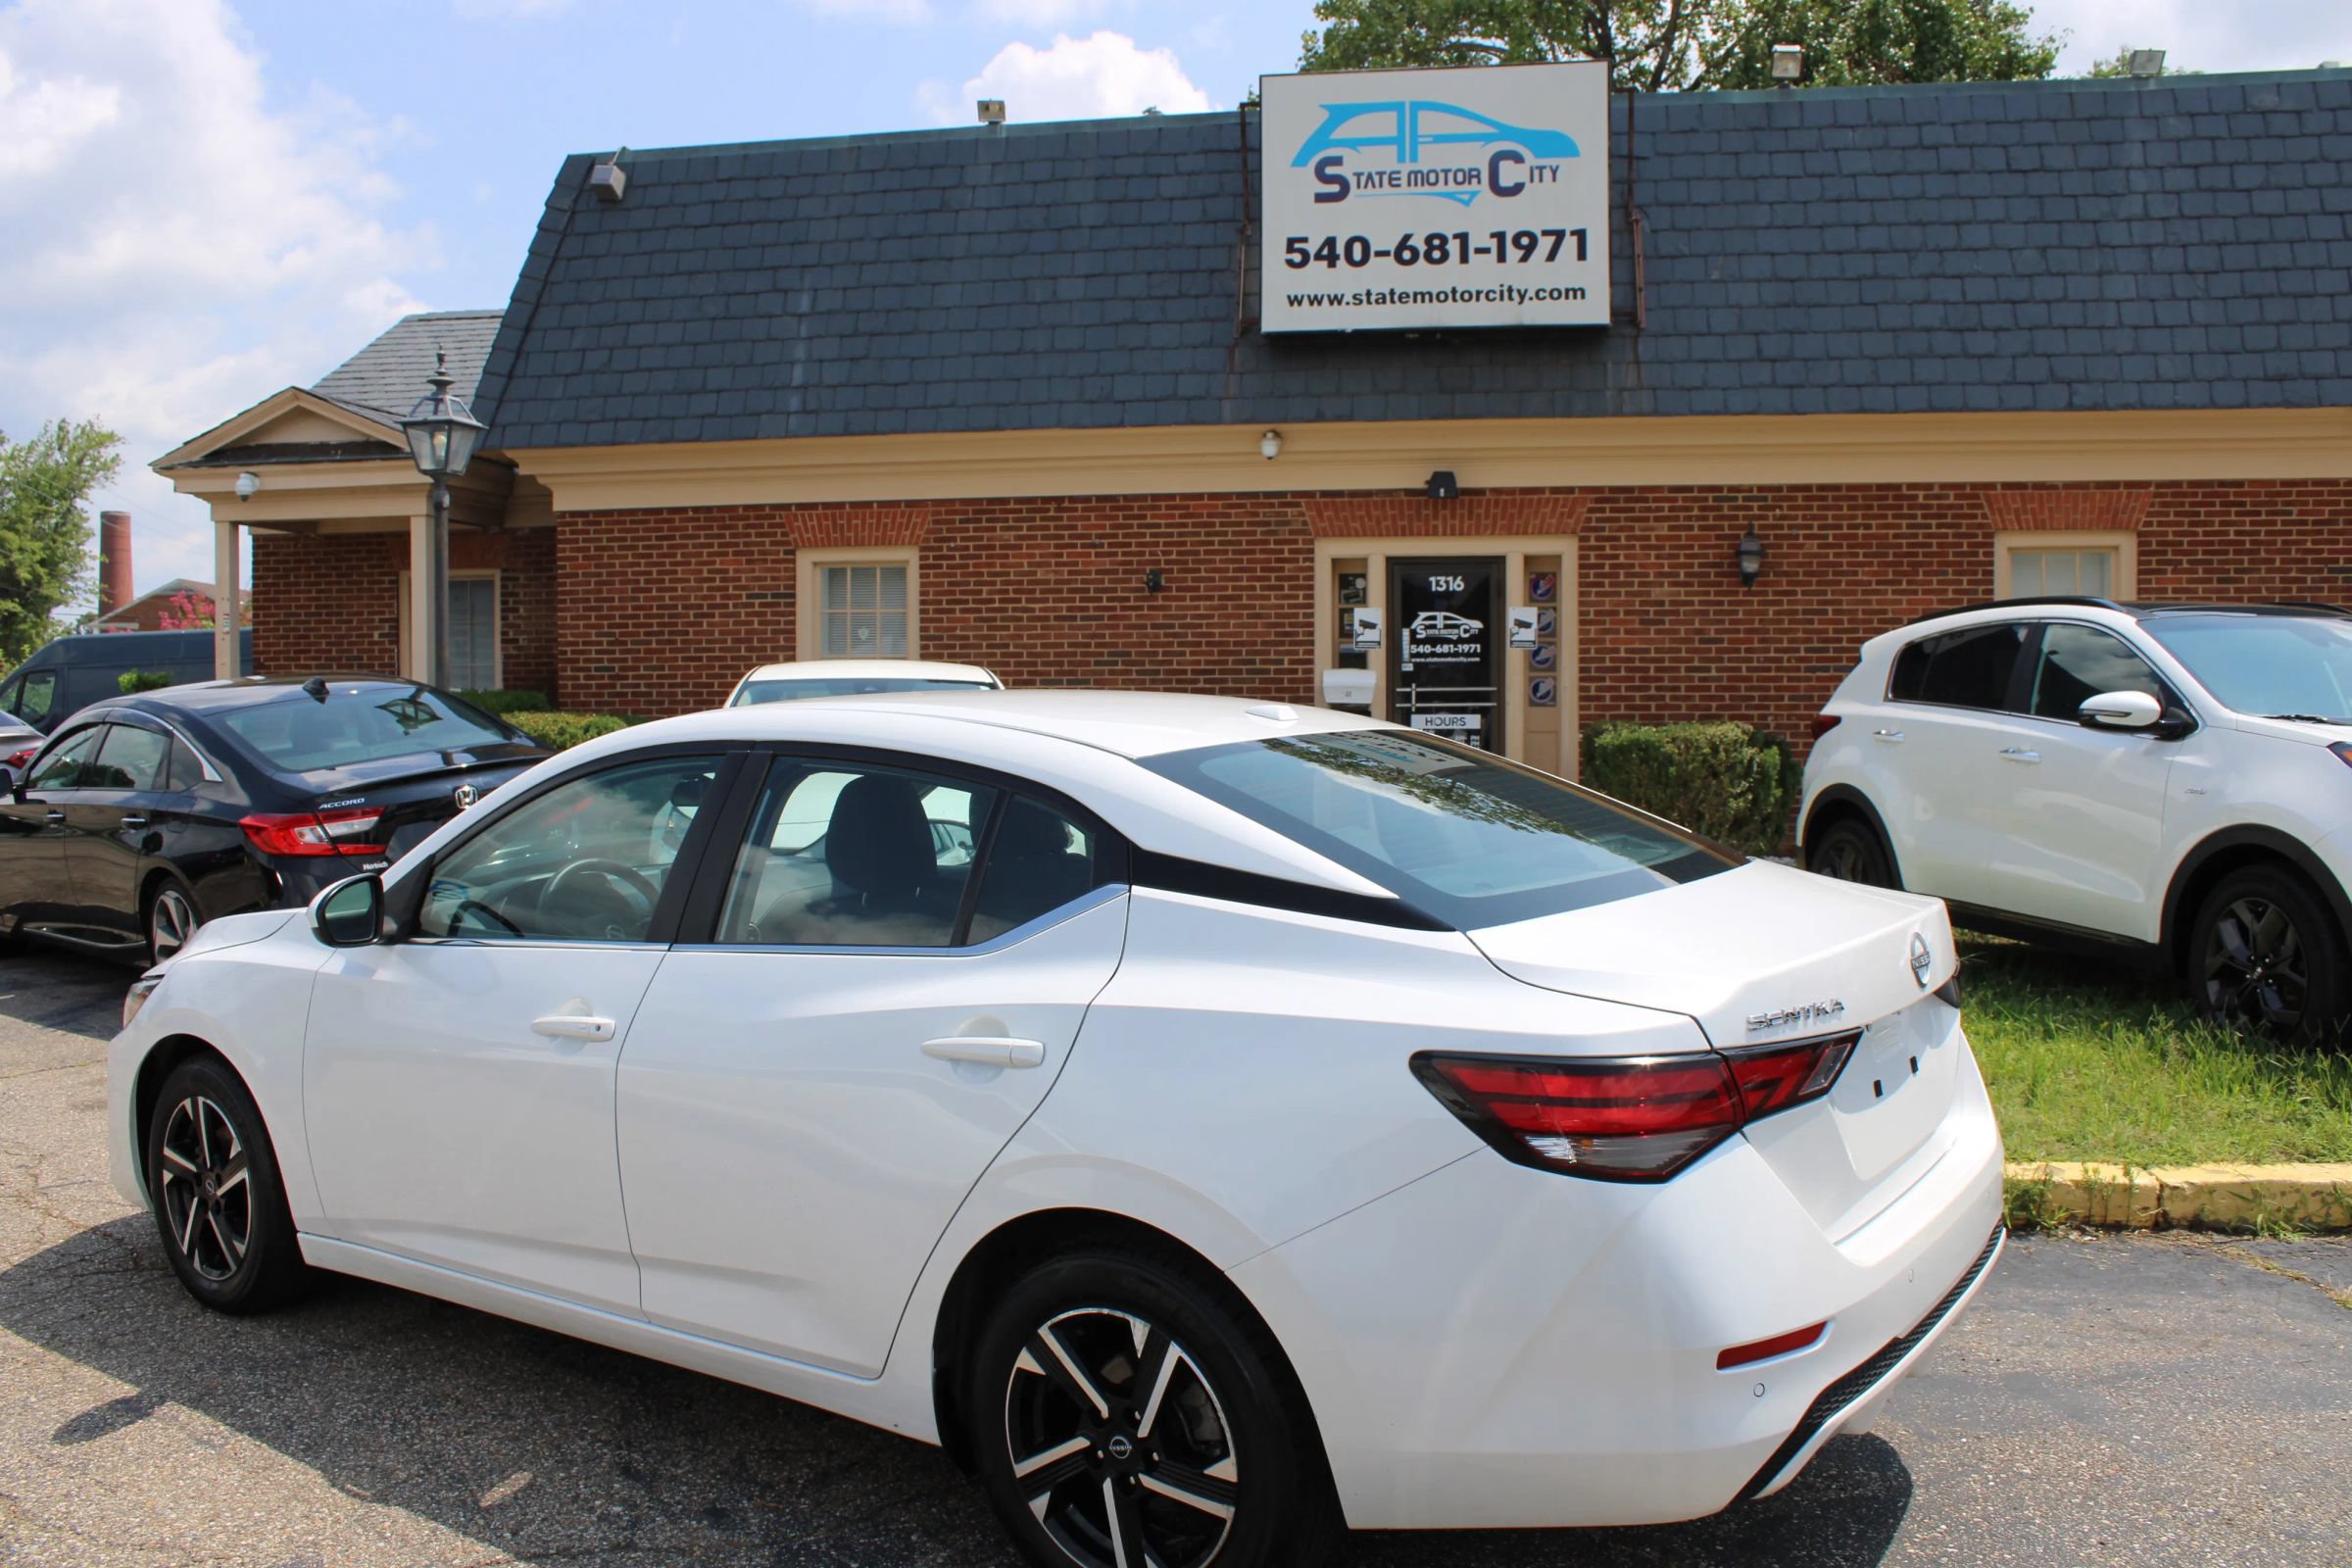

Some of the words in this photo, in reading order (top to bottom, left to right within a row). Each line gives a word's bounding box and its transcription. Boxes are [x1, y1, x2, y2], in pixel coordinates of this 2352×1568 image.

[1285, 228, 1587, 269] 540-681-1971
[1287, 283, 1586, 307] www.statemotorcity.com
[1429, 576, 1465, 592] 1316
[1410, 644, 1481, 654] 540-681-1971
[1425, 716, 1467, 727] HOURS
[319, 798, 365, 808] ACCORD
